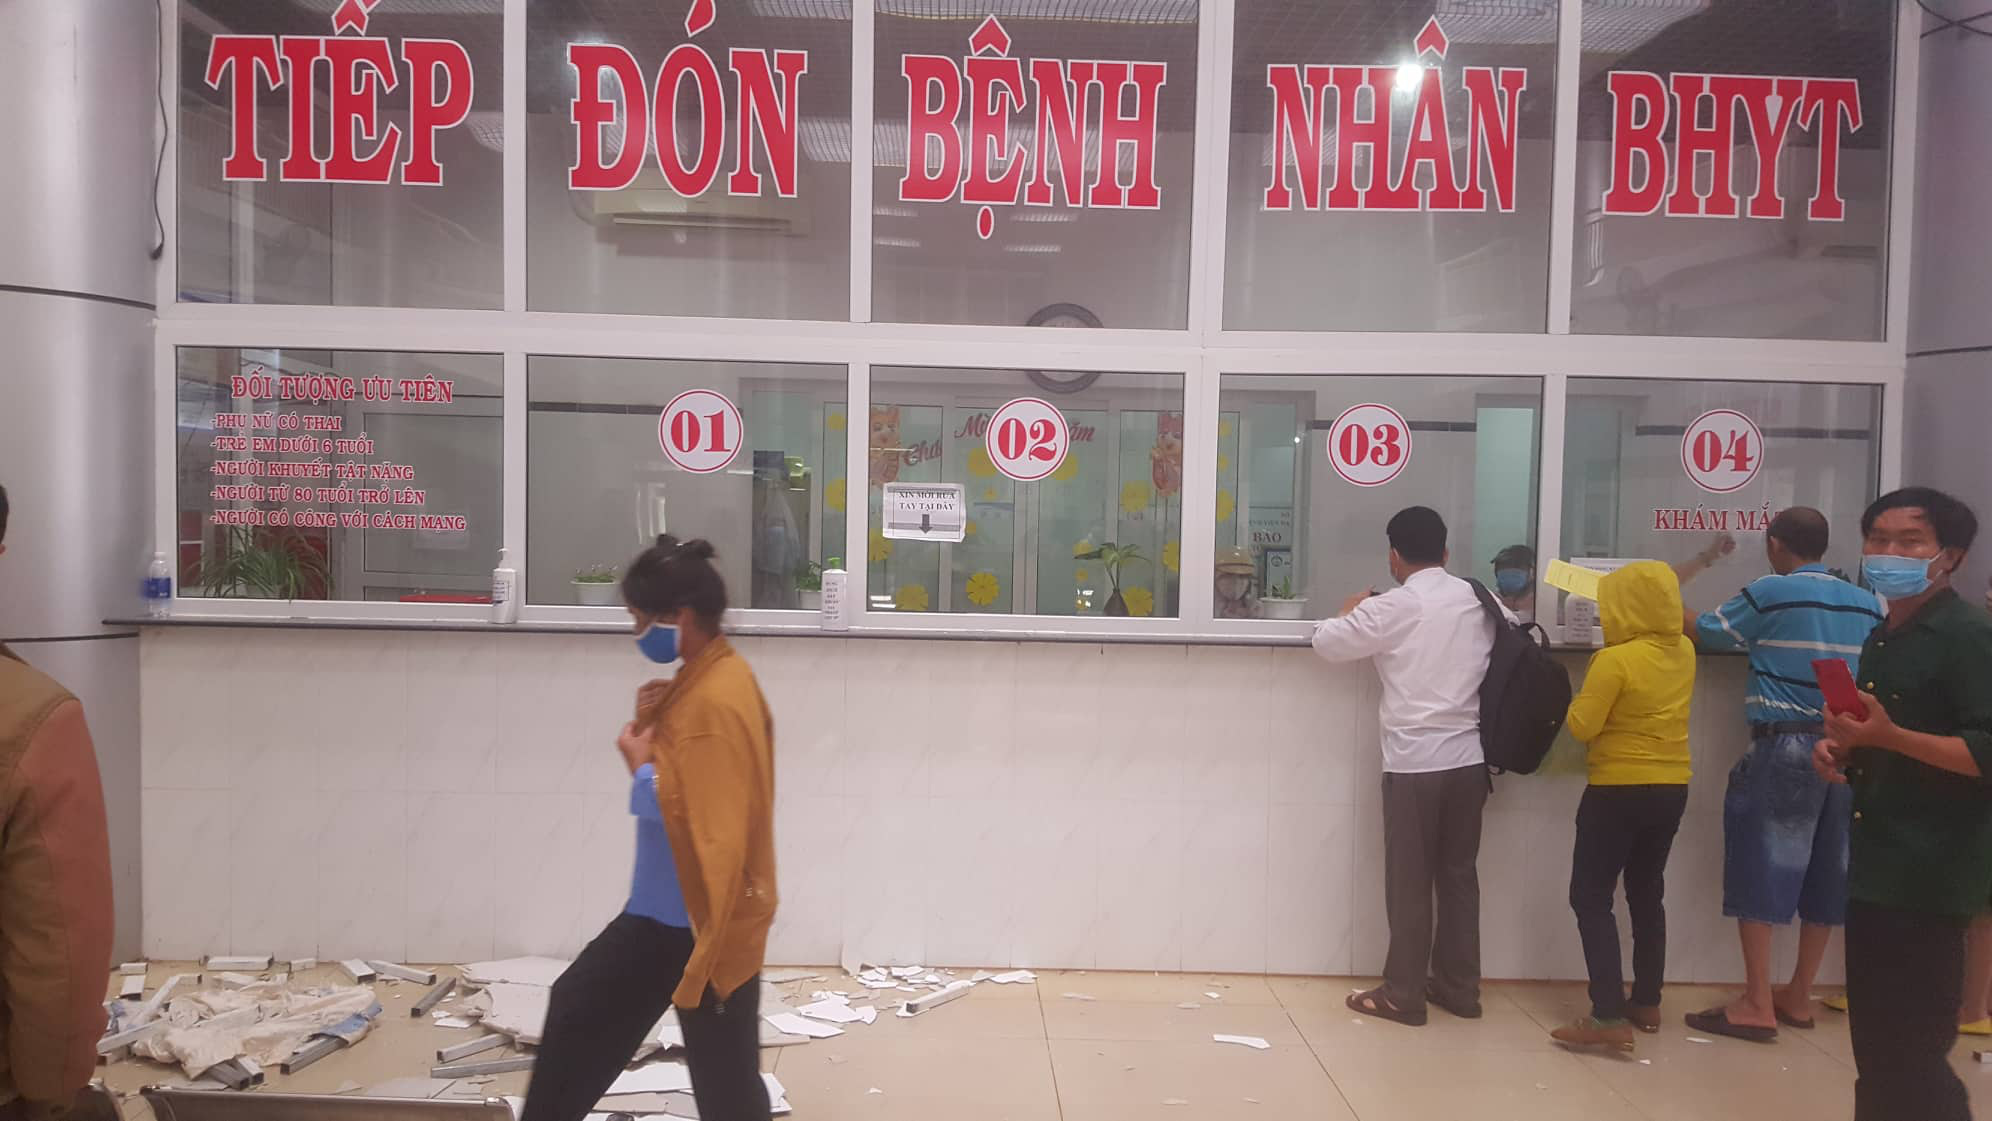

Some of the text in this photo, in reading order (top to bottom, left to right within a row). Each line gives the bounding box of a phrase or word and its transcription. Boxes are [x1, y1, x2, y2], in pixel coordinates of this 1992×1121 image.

[205, 0, 1863, 239] TIẾP ĐÓN BỆNH NHÂN BHYT
[231, 366, 455, 405] ĐỐI TƯỢNG ƯU TIÊN
[277, 410, 299, 430] CÓ
[303, 415, 342, 432] THAI
[670, 409, 733, 453] 01
[252, 436, 276, 452] EM
[279, 434, 318, 454] DƯỚI
[322, 438, 333, 454] 6
[336, 431, 375, 454] TUỔI
[997, 417, 1058, 462] 02
[1338, 423, 1403, 466] 03
[1692, 429, 1755, 473] 04
[267, 456, 332, 478] KHUYẾT
[335, 460, 366, 482] TẬT
[370, 461, 415, 483] NẶNG
[267, 482, 290, 502] TỪ
[293, 486, 313, 503] 80
[316, 480, 354, 504] TUỔI
[358, 483, 391, 505] TRỞ
[393, 486, 426, 506] LÊN
[898, 502, 918, 510] TAY
[267, 507, 289, 527] CÓ
[293, 508, 338, 528] CÔNG
[340, 509, 369, 529] VỚI
[371, 510, 417, 530] CÁCH
[420, 514, 468, 534] MẠNG
[1653, 501, 1784, 531] KHÁM MẮ
